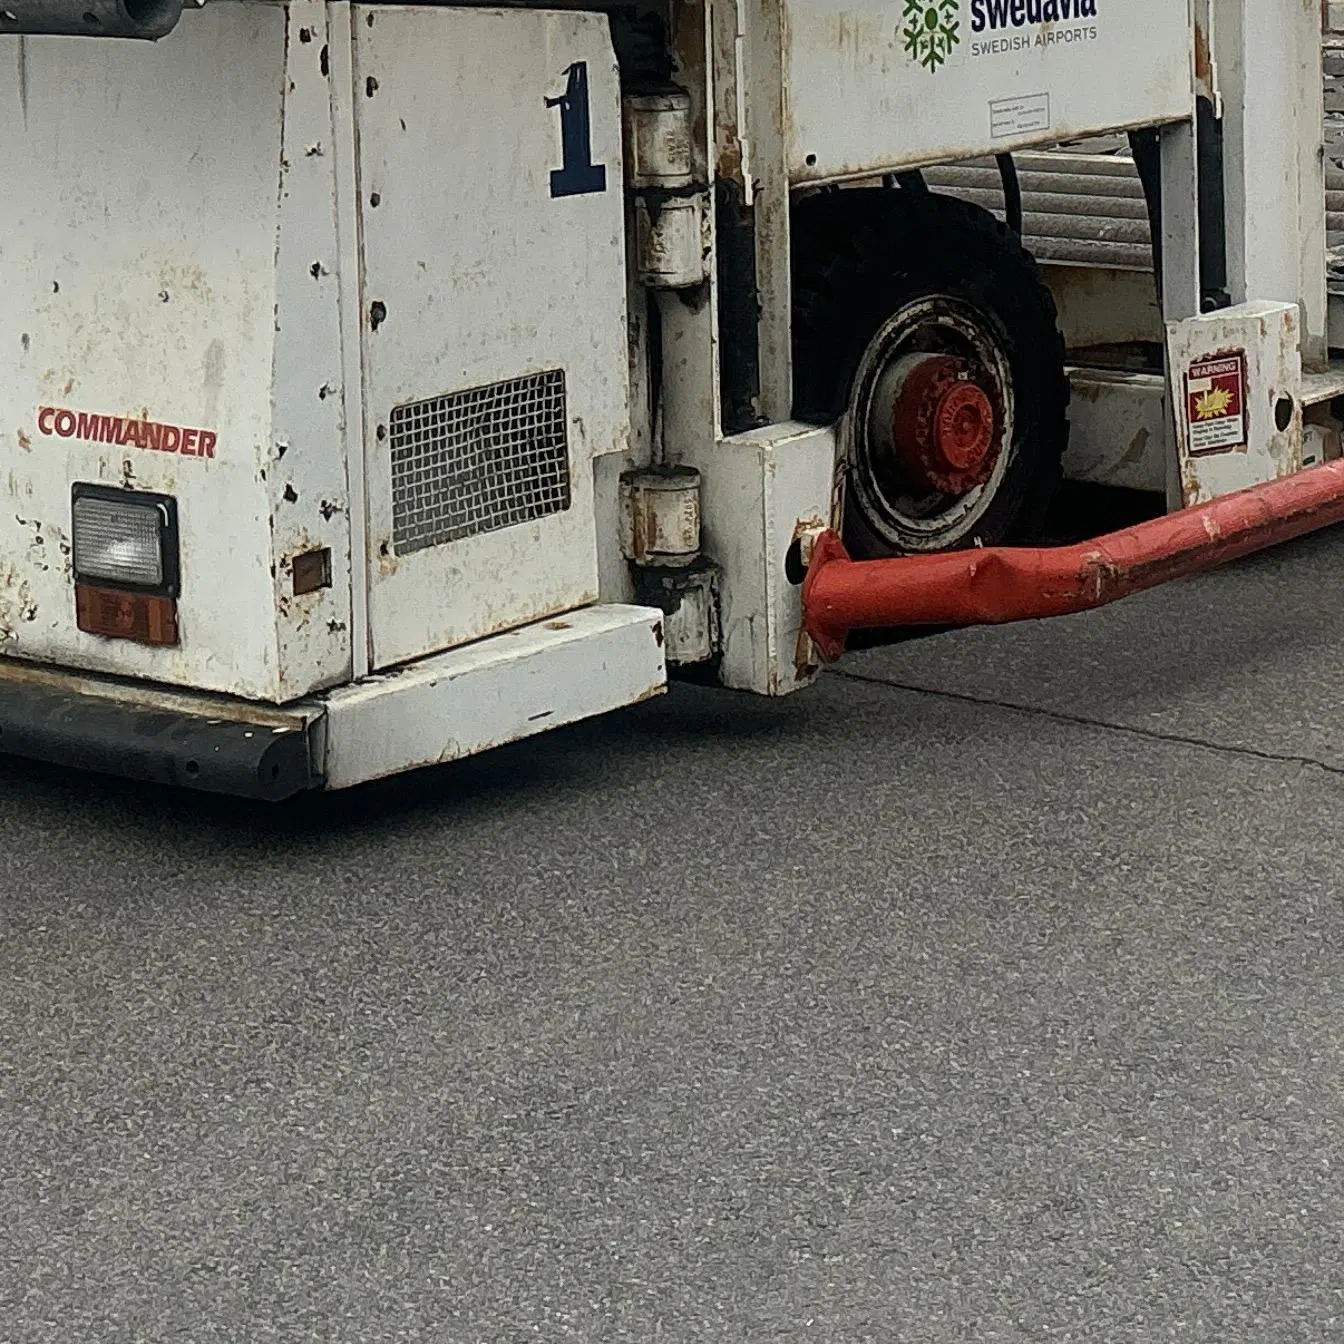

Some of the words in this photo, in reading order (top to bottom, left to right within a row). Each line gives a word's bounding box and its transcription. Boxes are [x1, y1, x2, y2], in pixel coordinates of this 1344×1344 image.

[971, 36, 1030, 56] SWEDISH
[1034, 26, 1097, 47] AIRPORTS
[543, 60, 606, 199] 1
[1191, 361, 1237, 377] WARNING
[38, 407, 218, 459] COMMANDER
